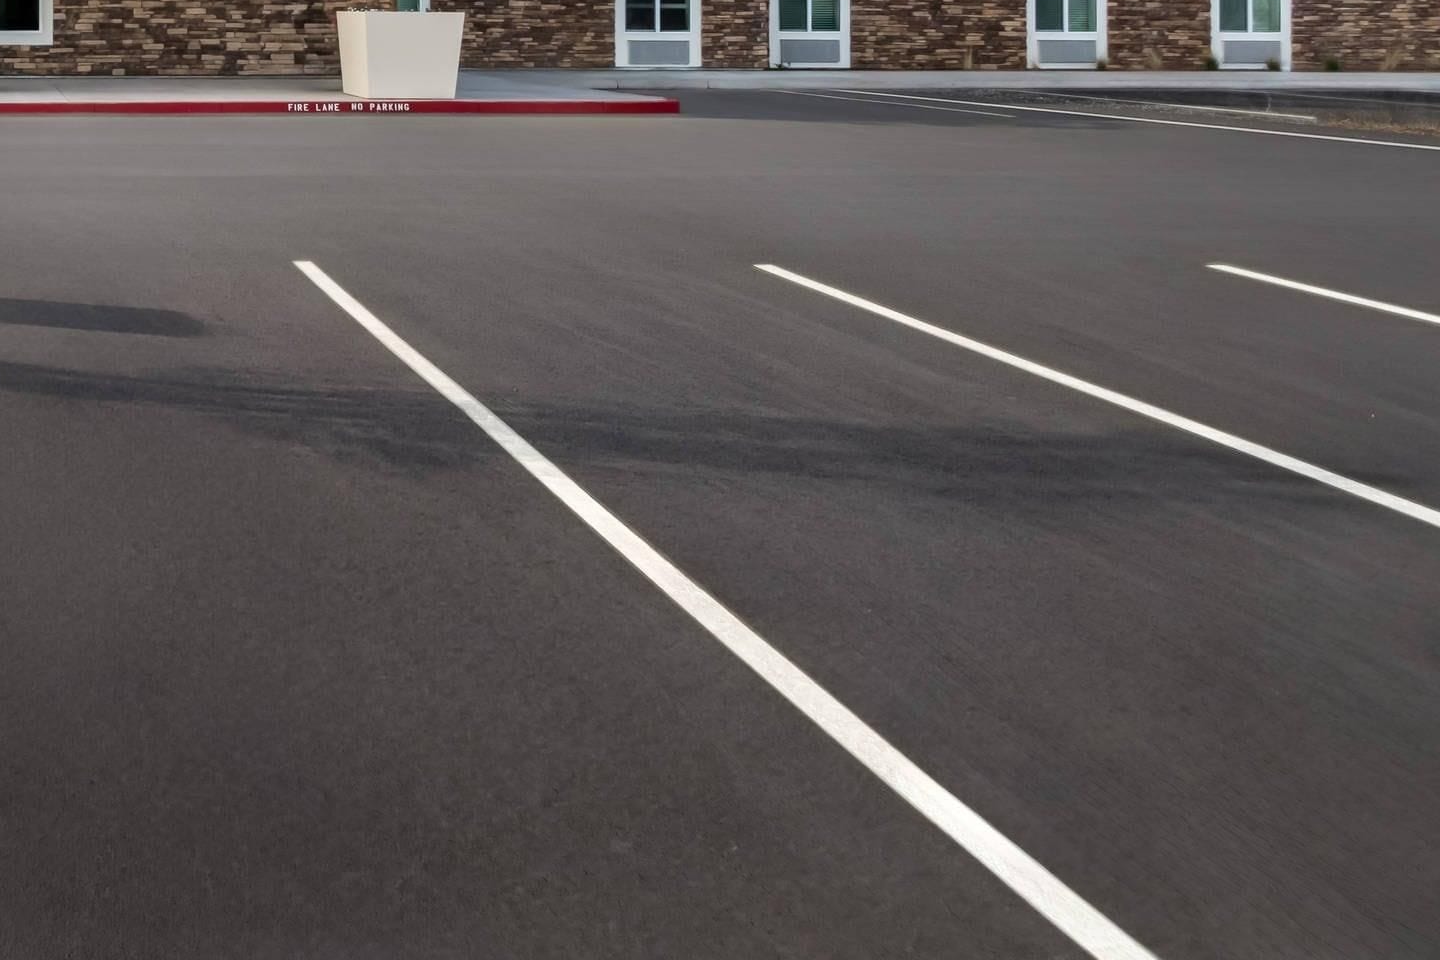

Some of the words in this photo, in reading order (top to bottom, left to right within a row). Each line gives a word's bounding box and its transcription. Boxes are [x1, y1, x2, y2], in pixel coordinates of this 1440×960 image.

[288, 103, 309, 112] FIRE
[315, 103, 340, 112] LANE
[351, 102, 363, 111] NO
[369, 103, 410, 112] PARKING
